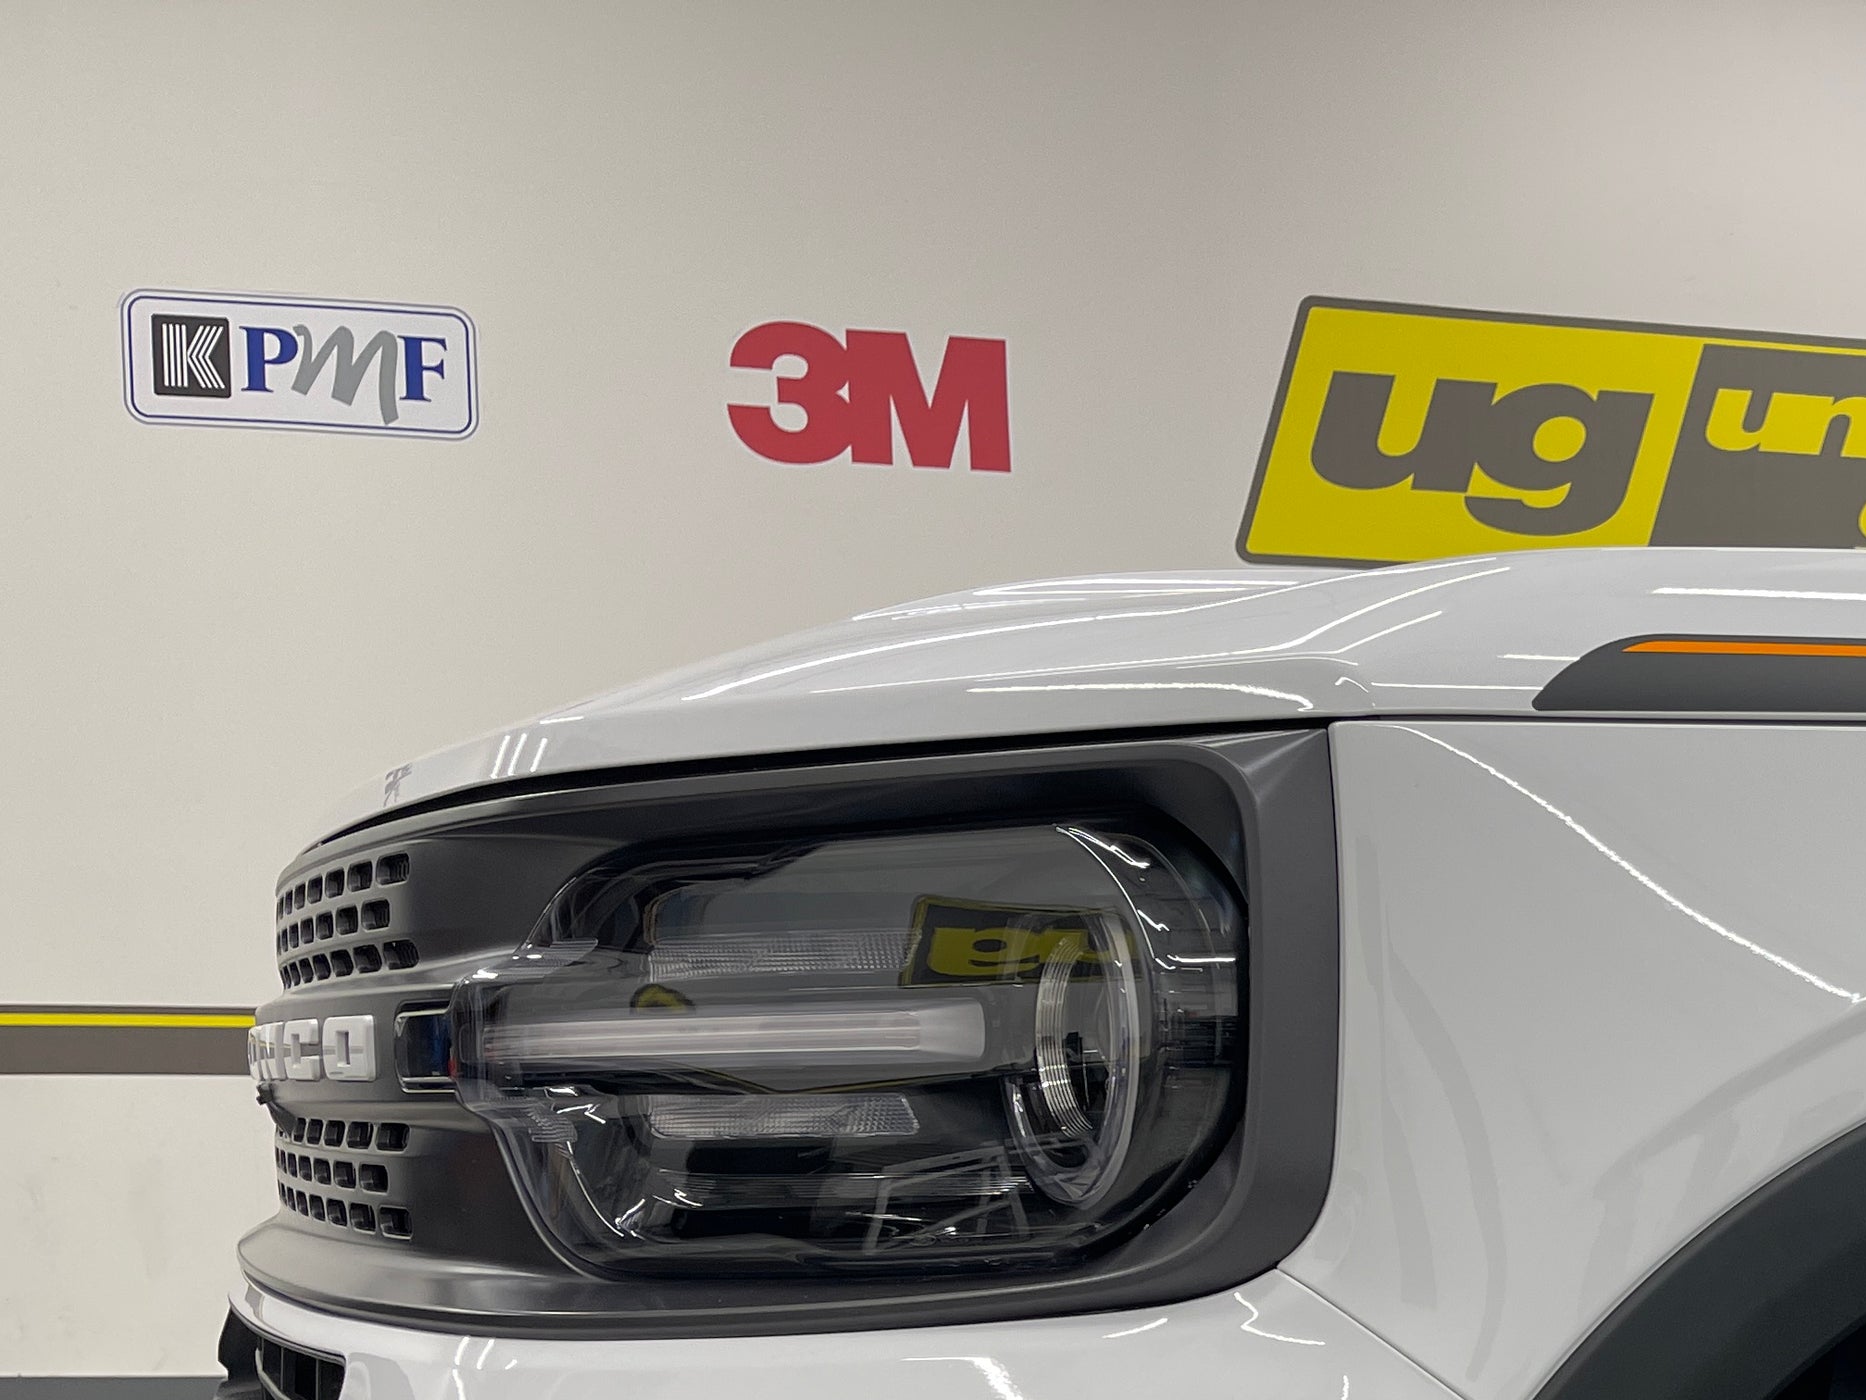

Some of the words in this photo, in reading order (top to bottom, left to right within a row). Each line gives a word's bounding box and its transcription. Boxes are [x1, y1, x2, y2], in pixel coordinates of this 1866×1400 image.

[158, 318, 448, 426] KPMF
[727, 320, 1012, 473] 3M
[1310, 370, 1656, 537] ug
